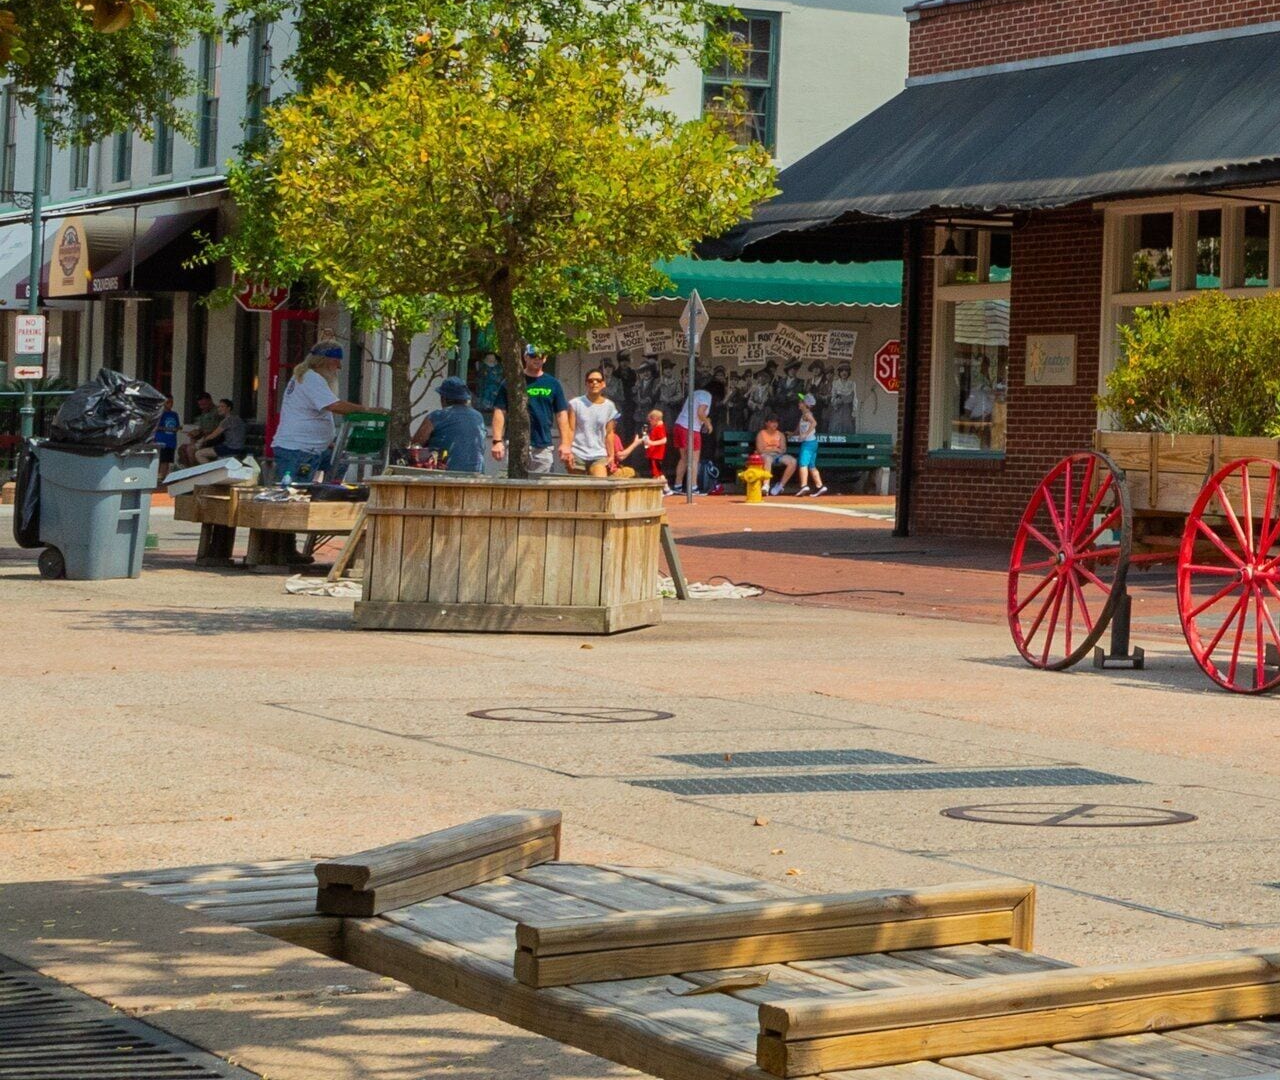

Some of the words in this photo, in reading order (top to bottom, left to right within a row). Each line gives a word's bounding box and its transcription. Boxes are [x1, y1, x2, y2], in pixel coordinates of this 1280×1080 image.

[591, 329, 611, 340] Save
[623, 329, 640, 339] NOT
[714, 335, 748, 346] SALOON
[774, 336, 801, 354] KING
[720, 348, 739, 356] GO!
[879, 355, 900, 378] ST
